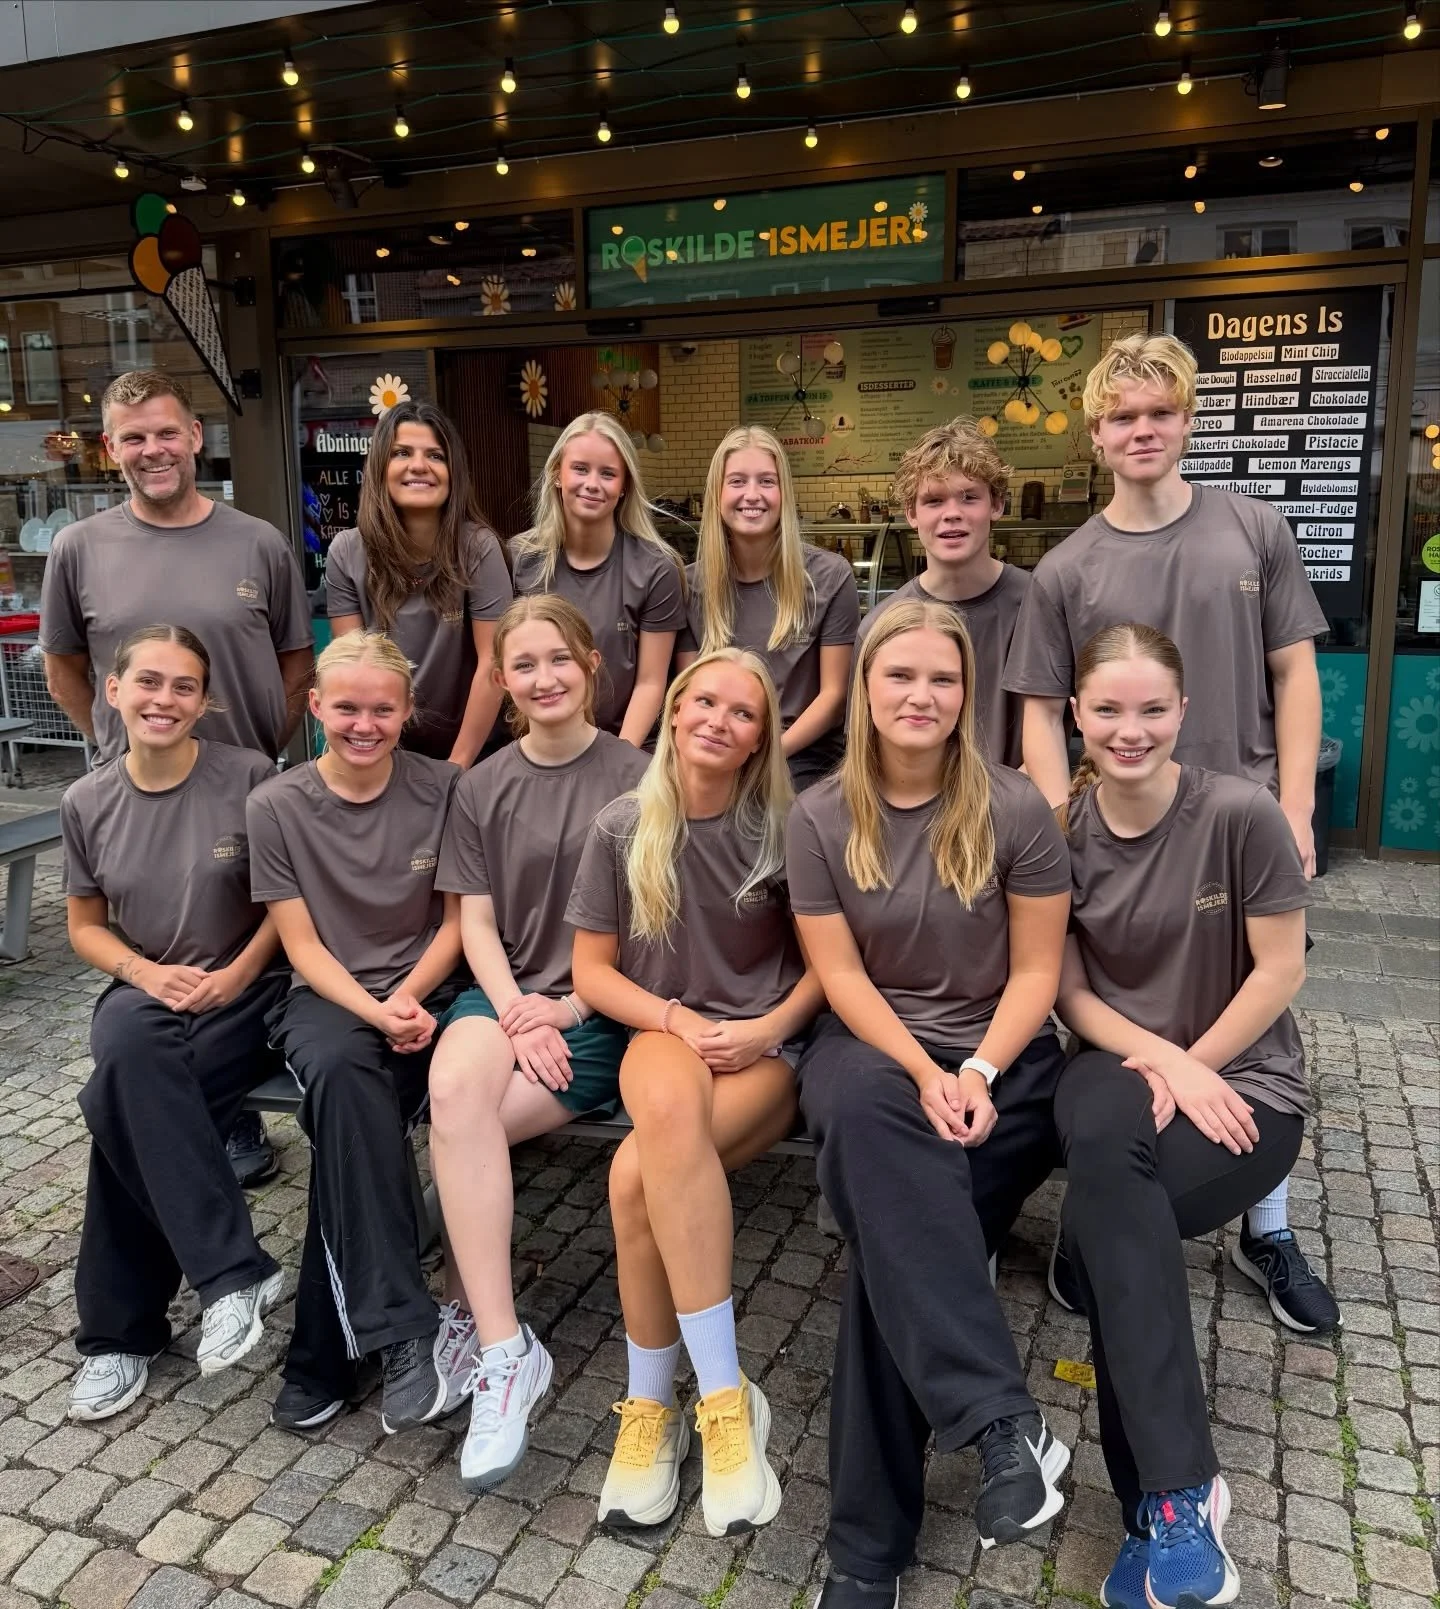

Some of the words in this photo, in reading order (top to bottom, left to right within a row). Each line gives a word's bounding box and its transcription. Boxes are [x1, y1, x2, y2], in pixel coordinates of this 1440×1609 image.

[602, 230, 755, 272] ROSKILDE
[1208, 312, 1308, 342] Dagens
[1318, 306, 1343, 333] Is
[1221, 349, 1273, 363] Blodappelsin
[1284, 346, 1308, 358] Mint
[1311, 345, 1337, 359] Chip
[1196, 375, 1210, 385] kie
[1211, 374, 1235, 385] Dough
[1246, 371, 1298, 384] Hasselnød
[1315, 368, 1369, 381] Stracciatella
[860, 381, 915, 391] ISDESSERTER
[1245, 393, 1295, 406] Hindbær
[1312, 392, 1367, 405] Chokolade
[1260, 416, 1304, 427] Amarena
[1307, 415, 1359, 426] Chokolade
[1232, 437, 1286, 450] Chokolade
[1309, 436, 1359, 449] Pistacie
[1181, 458, 1232, 472] Skildpadde
[1258, 459, 1297, 470] Lemon
[1301, 458, 1351, 472] Marengs
[319, 470, 349, 485] ALLE
[1302, 484, 1357, 494] Hyldeblomst
[1272, 502, 1354, 515] aramel-Fudge
[1305, 525, 1343, 537] Citron
[1300, 547, 1343, 559] Rocher
[1306, 567, 1343, 580] akrids
